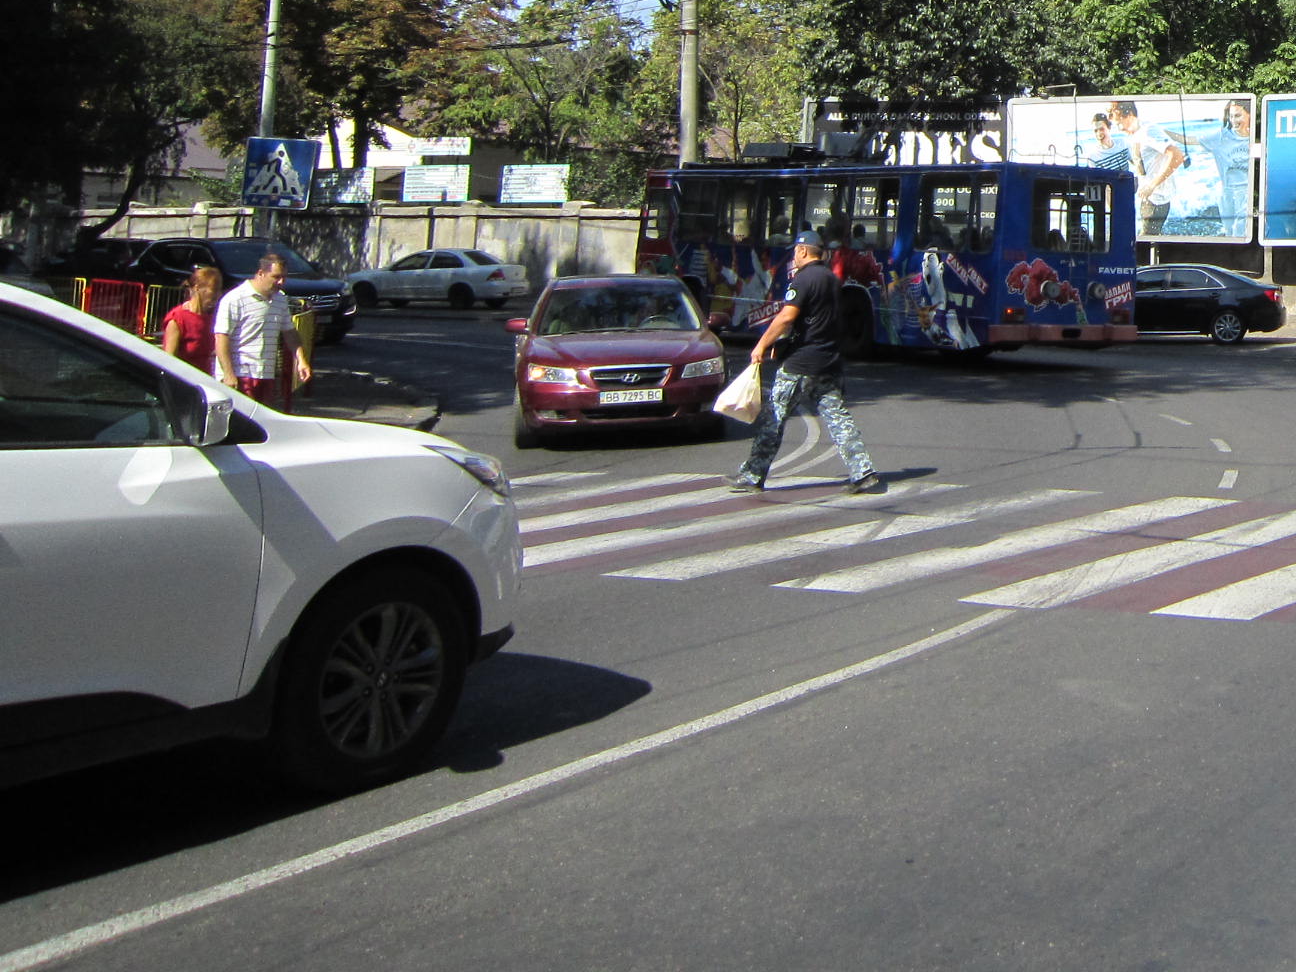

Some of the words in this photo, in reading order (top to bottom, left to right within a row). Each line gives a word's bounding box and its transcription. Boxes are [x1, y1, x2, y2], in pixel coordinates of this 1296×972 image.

[1098, 267, 1135, 275] FAVBET
[606, 393, 619, 403] BB
[622, 391, 644, 402] 7295
